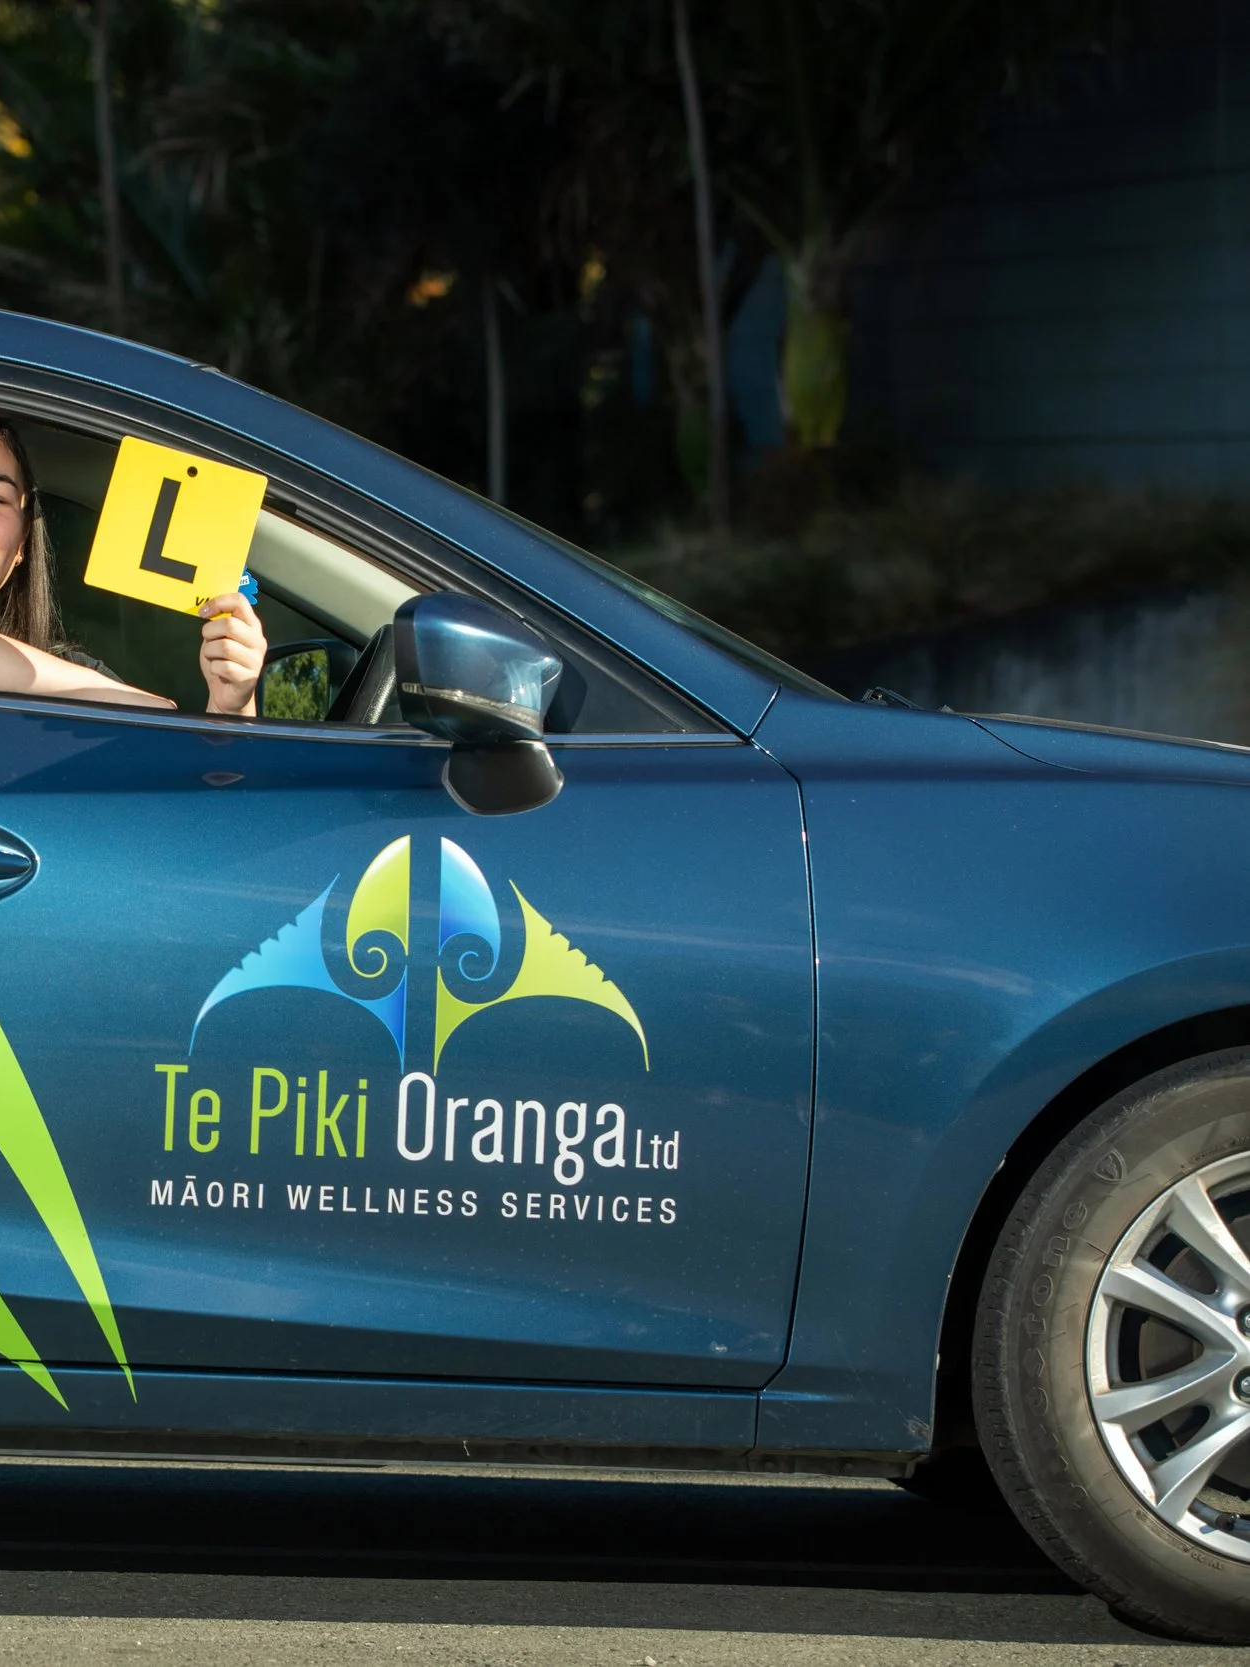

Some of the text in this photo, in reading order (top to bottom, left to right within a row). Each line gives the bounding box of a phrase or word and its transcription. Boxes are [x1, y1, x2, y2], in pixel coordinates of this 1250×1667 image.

[139, 477, 198, 584] L
[154, 1063, 680, 1186] Te Piki Oranga Ltd
[150, 1175, 677, 1225] MĀORI WELLNESS SERVICES
[1022, 1201, 1089, 1508] estone
